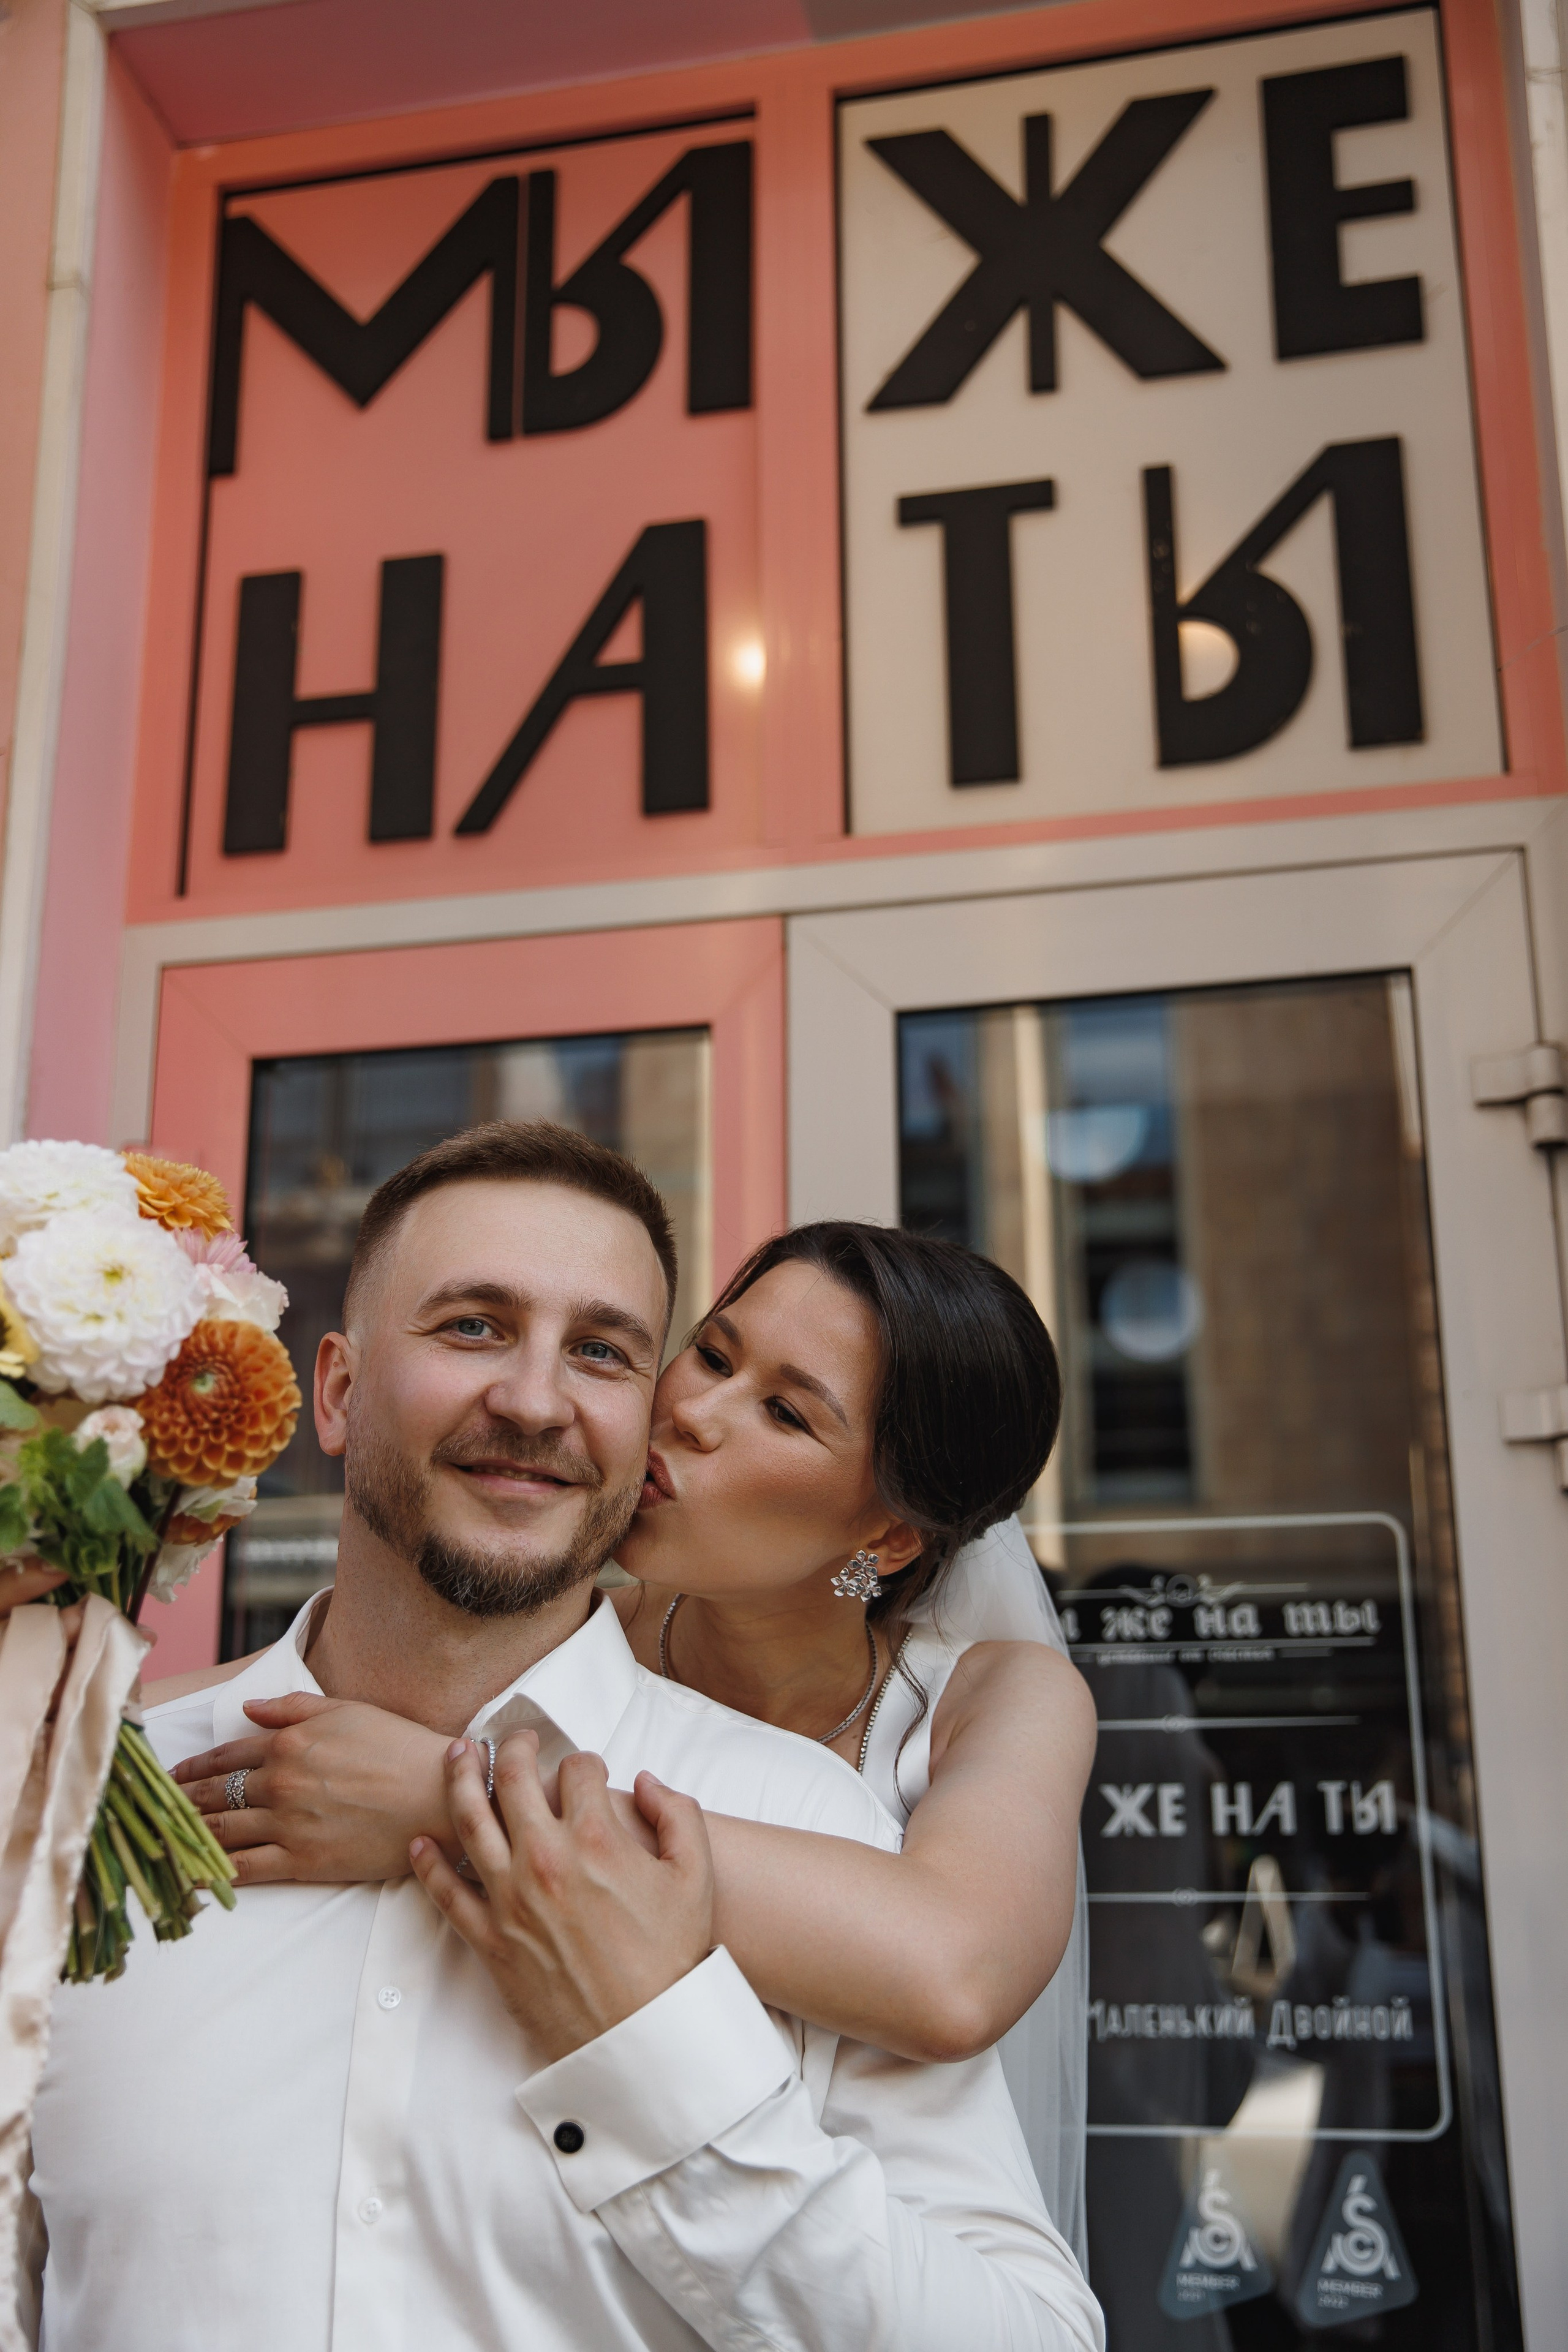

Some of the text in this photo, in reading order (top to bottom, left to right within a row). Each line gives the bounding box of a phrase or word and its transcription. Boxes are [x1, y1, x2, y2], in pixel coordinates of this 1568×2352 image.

[207, 53, 1427, 479] МЫ ЖЕ
[221, 435, 1426, 859] НА ТЫ
[1193, 1603, 1261, 1638] на
[1283, 1599, 1380, 1636] ты
[1099, 1780, 1398, 1837] ЖЕ НА ТЫ
